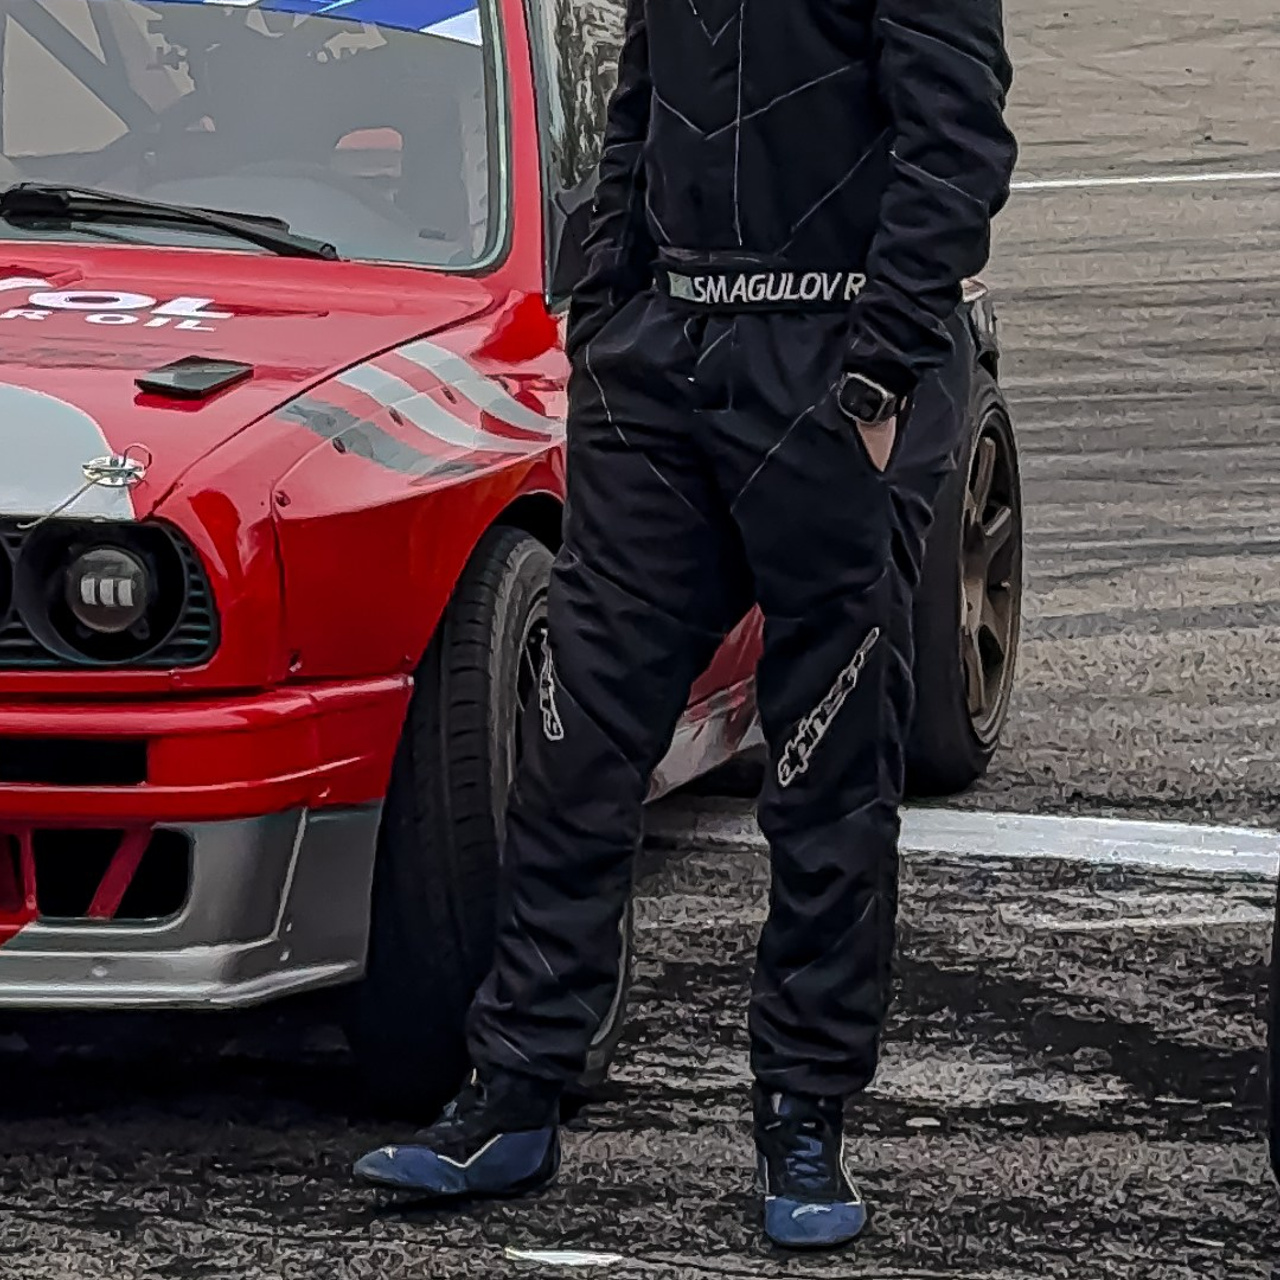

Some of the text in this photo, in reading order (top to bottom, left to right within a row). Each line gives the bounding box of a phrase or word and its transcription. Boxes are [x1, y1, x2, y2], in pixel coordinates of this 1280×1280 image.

[692, 272, 867, 304] SMAGULOV R
[85, 312, 216, 332] OIL
